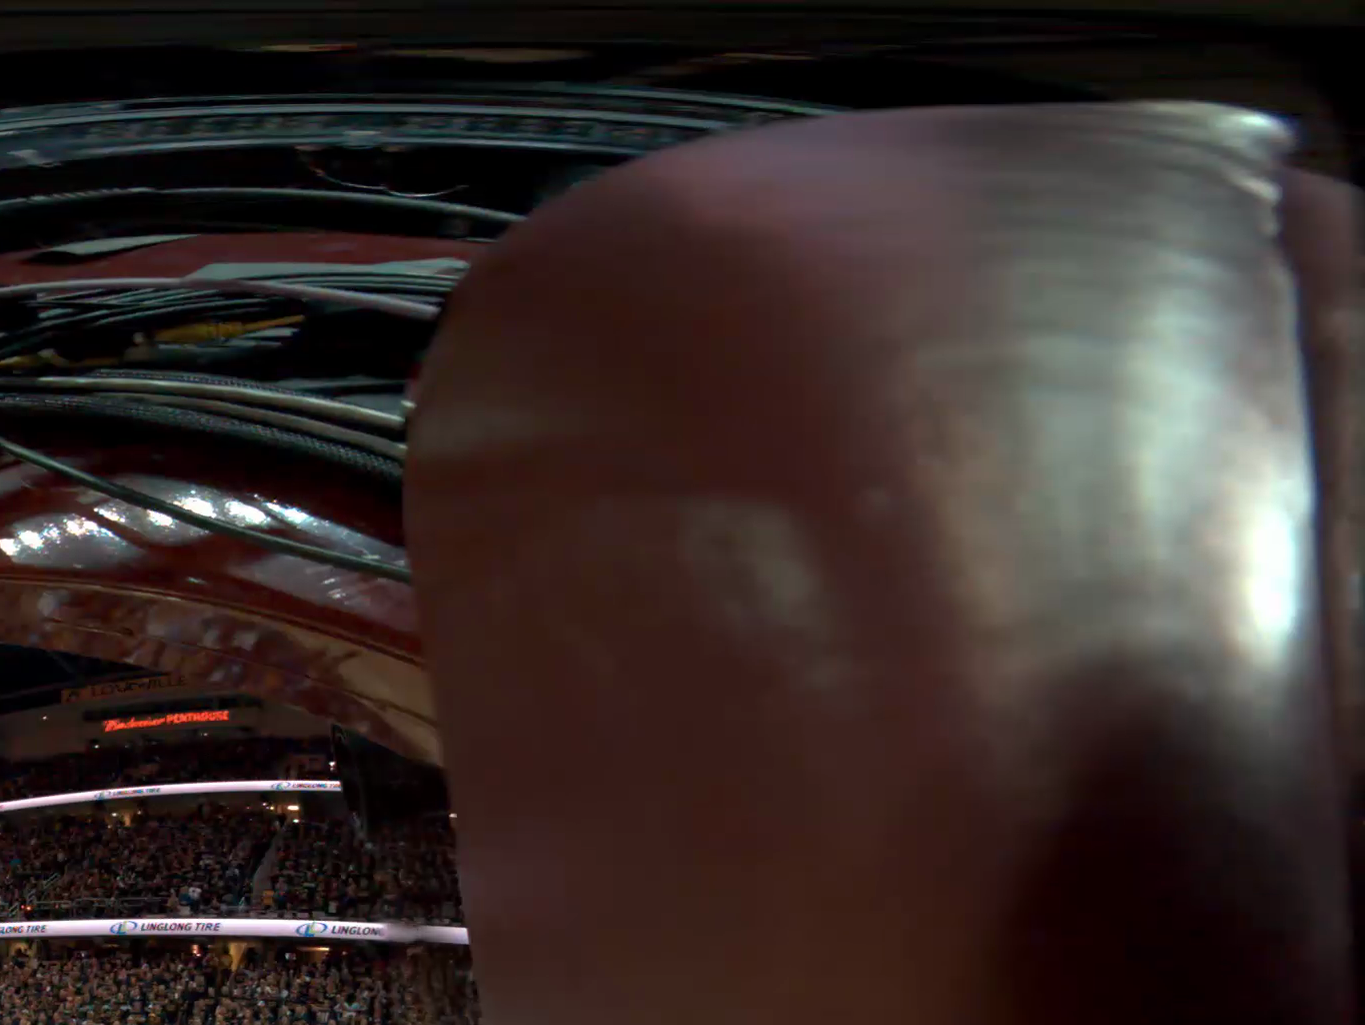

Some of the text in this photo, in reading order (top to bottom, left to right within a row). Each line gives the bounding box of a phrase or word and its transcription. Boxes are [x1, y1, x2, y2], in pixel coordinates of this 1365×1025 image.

[166, 710, 230, 725] PENTHOUSE
[26, 924, 46, 934] TIRE
[140, 920, 221, 934] LINGLONG TIRE
